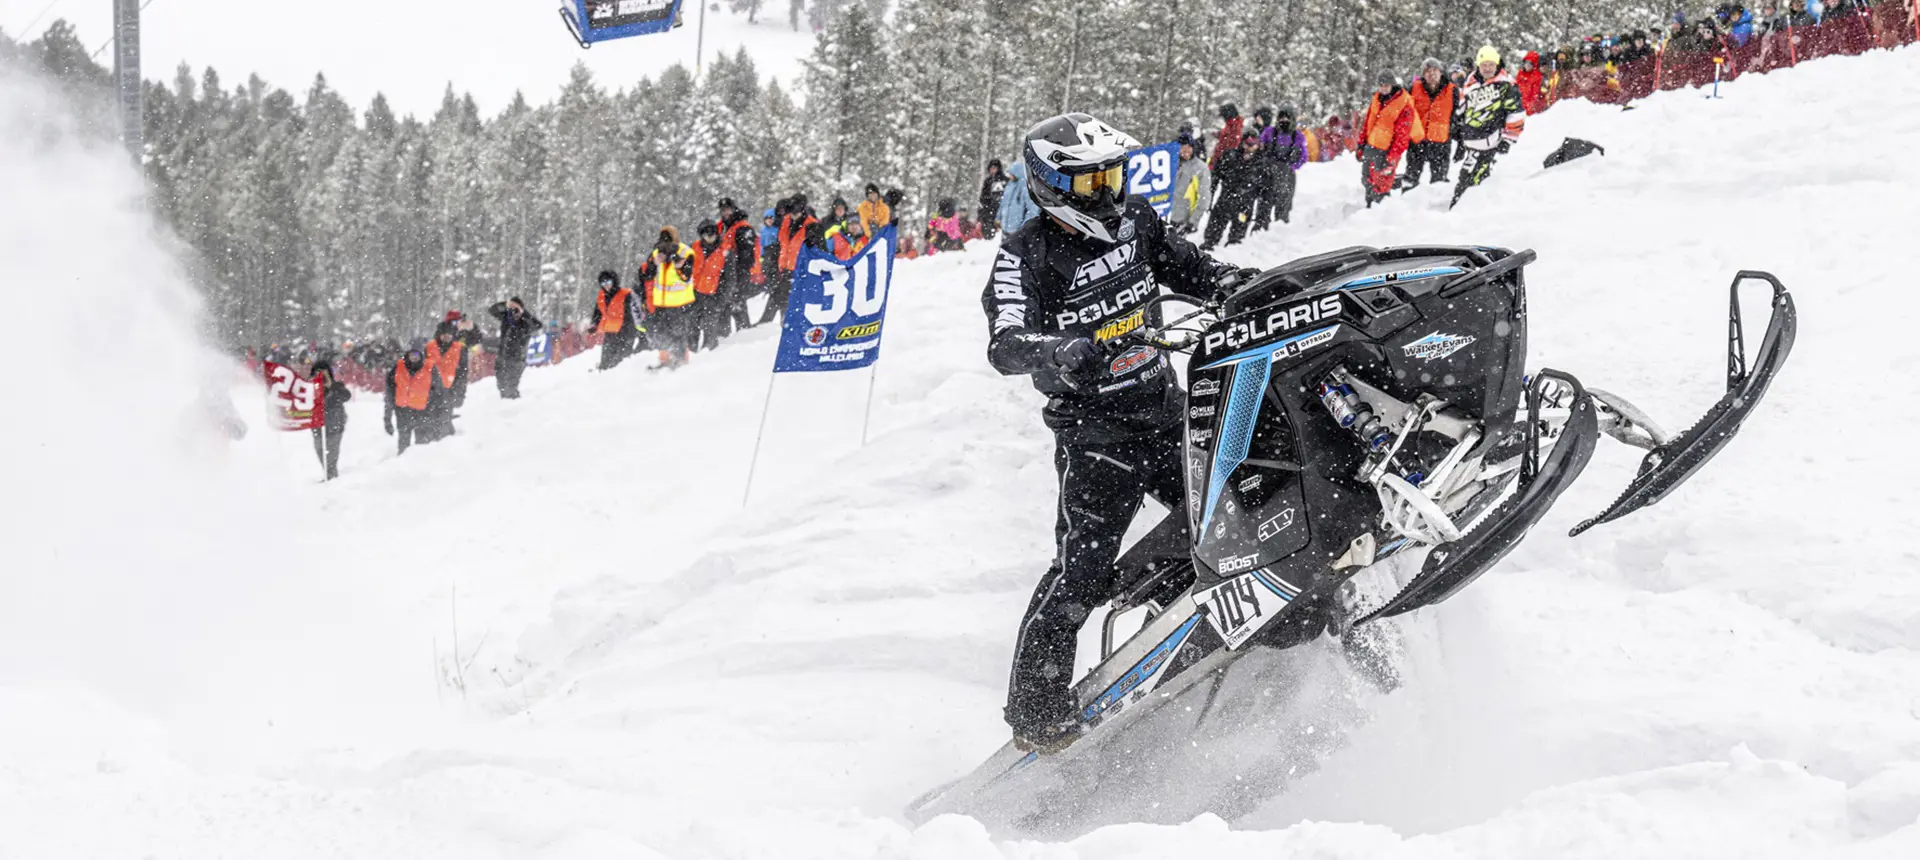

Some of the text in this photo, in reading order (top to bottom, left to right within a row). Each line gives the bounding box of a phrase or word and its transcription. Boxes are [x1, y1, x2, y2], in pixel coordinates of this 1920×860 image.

[1129, 149, 1172, 195] 29
[804, 237, 888, 325] 30
[1204, 293, 1342, 356] POLARIS
[800, 346, 828, 356] WORLD
[1274, 349, 1286, 358] ON
[1301, 331, 1333, 348] OFFROAD
[1405, 335, 1474, 356] Walker Evans
[268, 365, 315, 411] 29
[1218, 552, 1260, 574] BOOST
